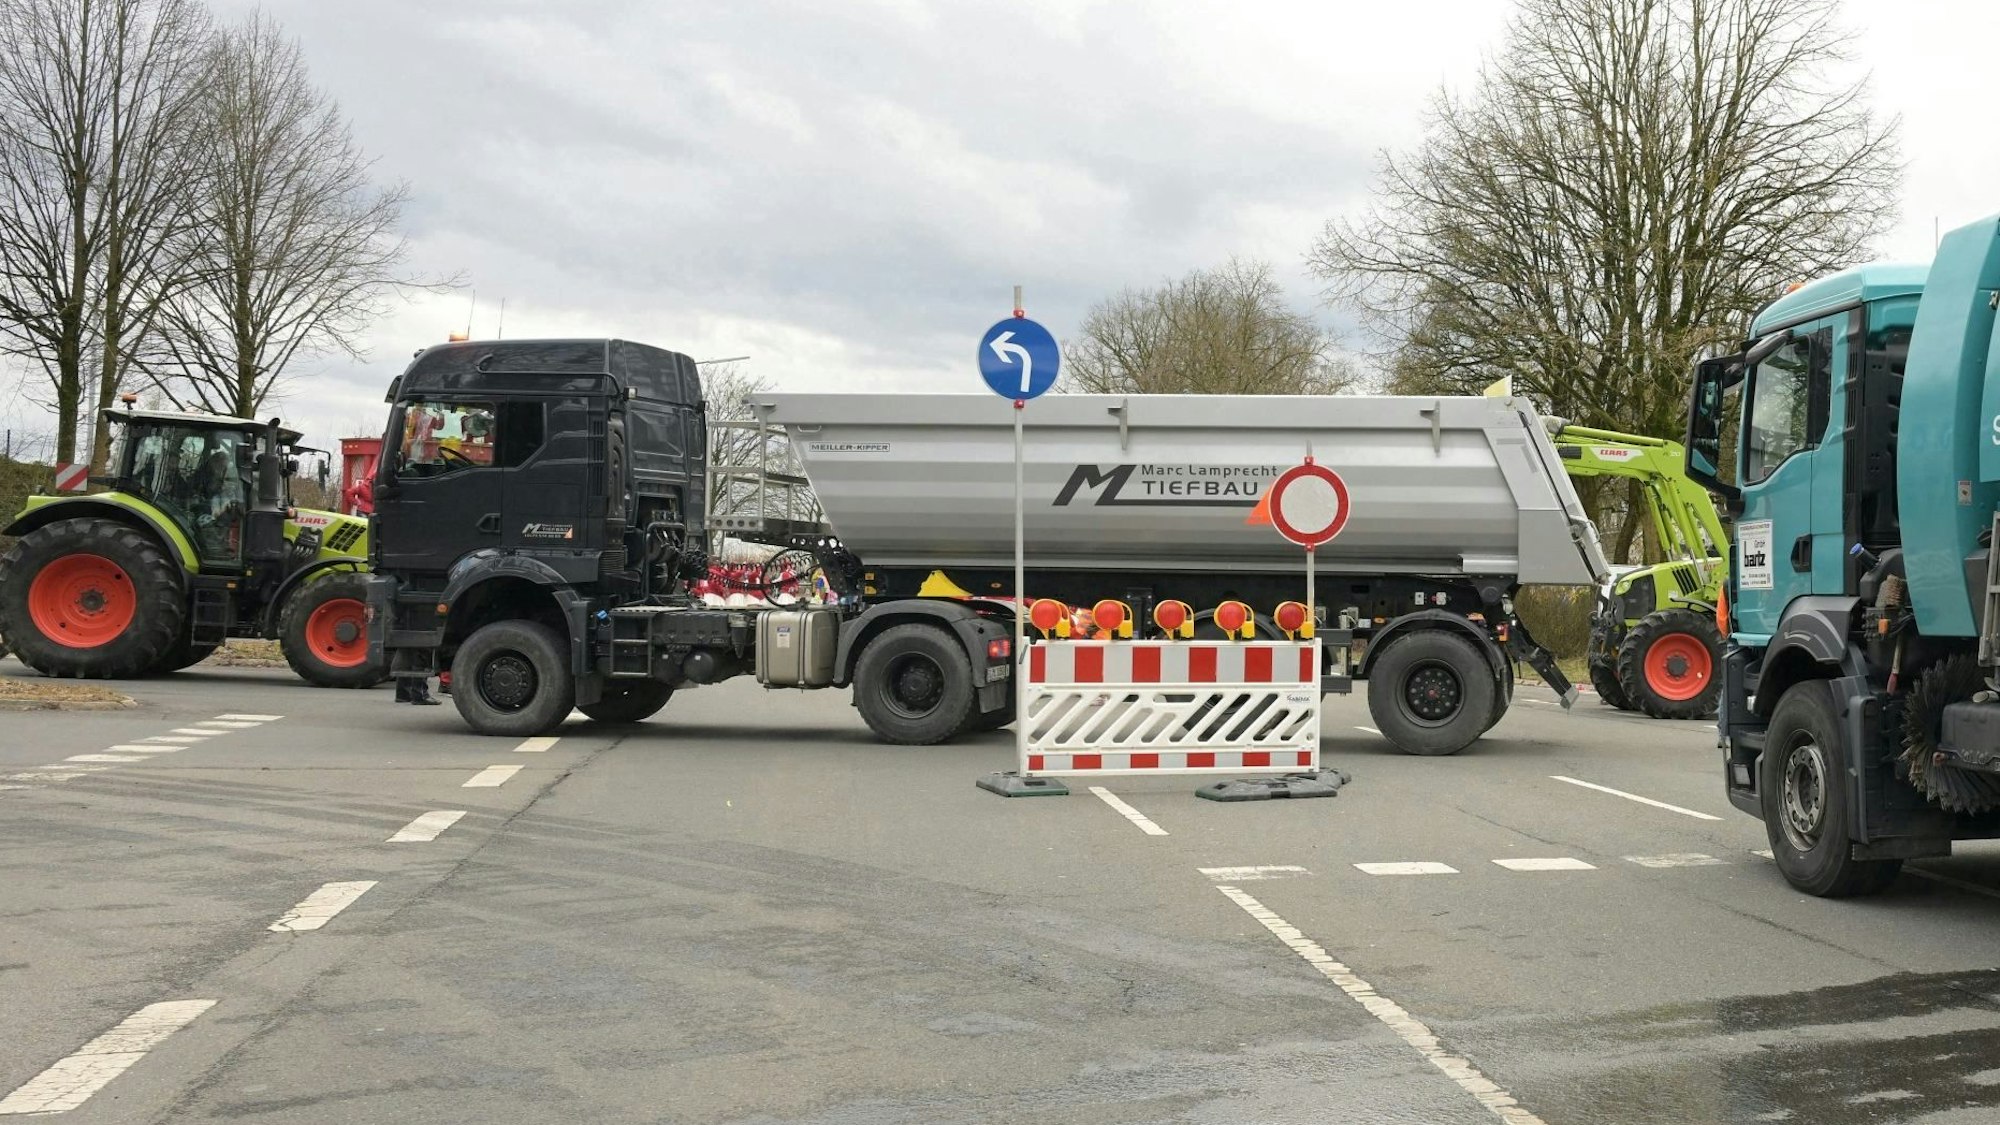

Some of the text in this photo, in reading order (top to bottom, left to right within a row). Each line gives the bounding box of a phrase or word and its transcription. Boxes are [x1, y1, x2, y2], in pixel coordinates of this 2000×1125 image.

[1600, 449, 1629, 457] CLAAS
[1141, 464, 1278, 478] Marc Lamprecht
[1142, 480, 1258, 496] TIEFBAU
[1744, 541, 1766, 568] bartz
